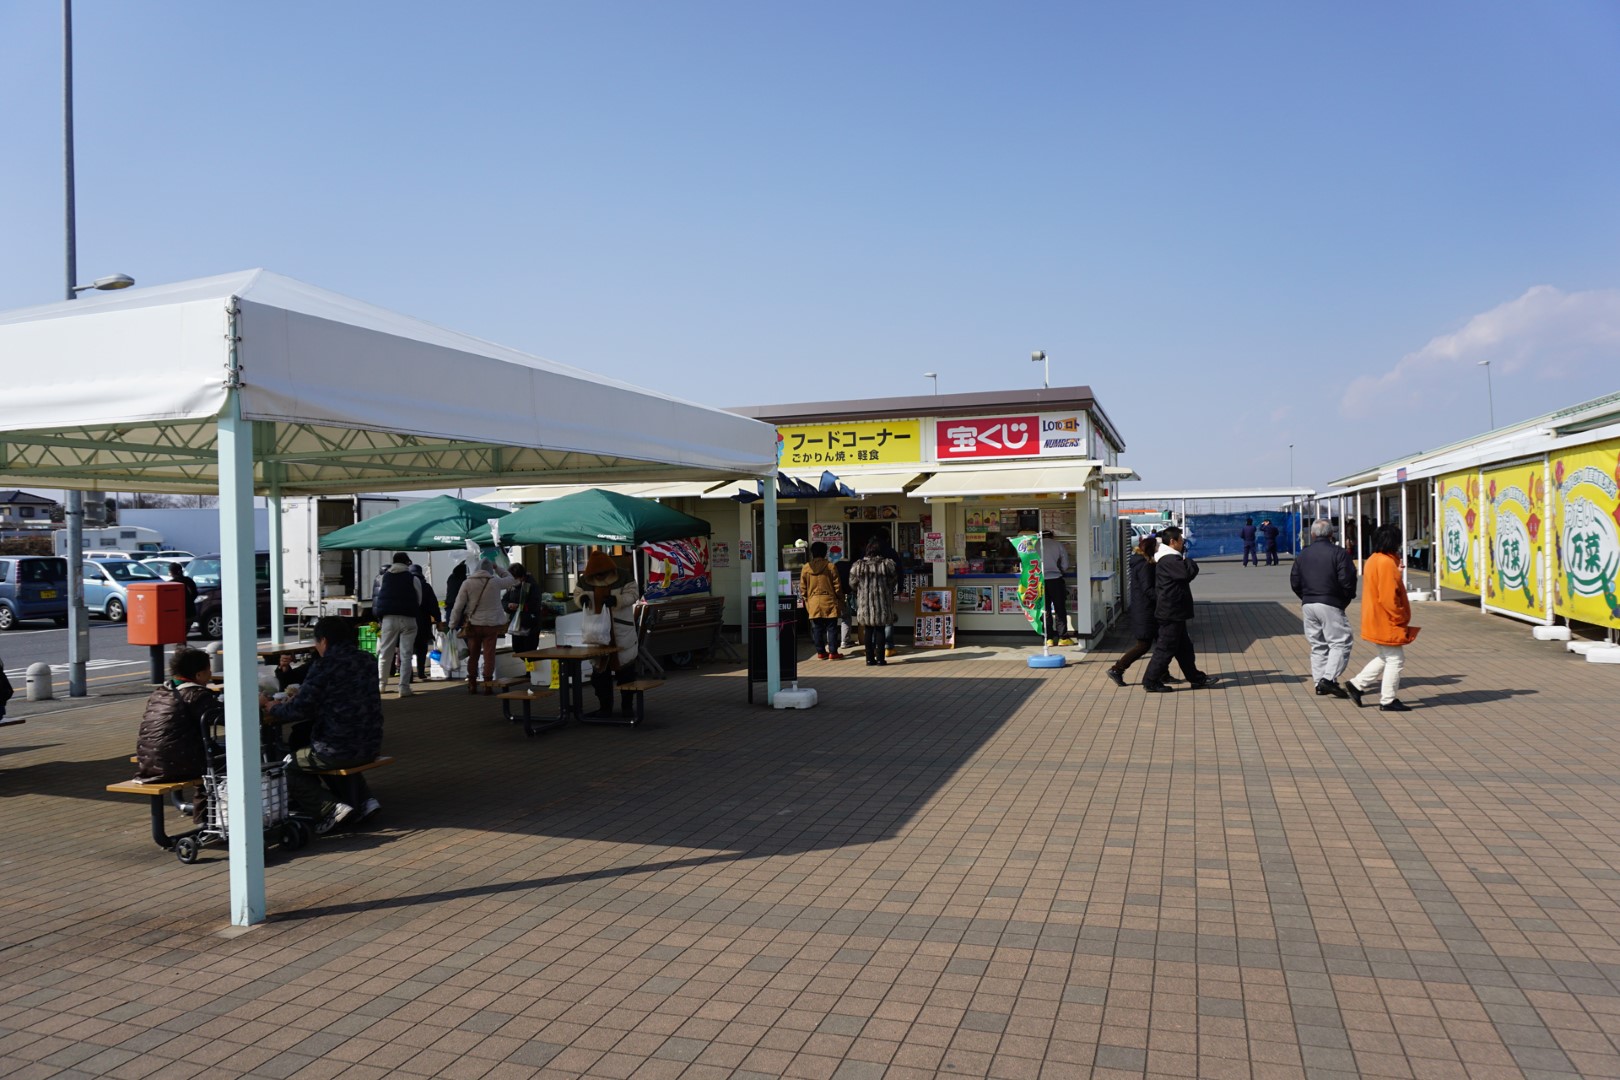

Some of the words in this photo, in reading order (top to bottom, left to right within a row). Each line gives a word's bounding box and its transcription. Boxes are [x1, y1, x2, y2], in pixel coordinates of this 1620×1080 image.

[1043, 420, 1063, 432] LOTO
[791, 428, 911, 450] フードコーナー
[947, 422, 1028, 453] 宝くじ
[1044, 437, 1080, 449] NUMBERS
[792, 449, 880, 463] ごかりん焼・軽食
